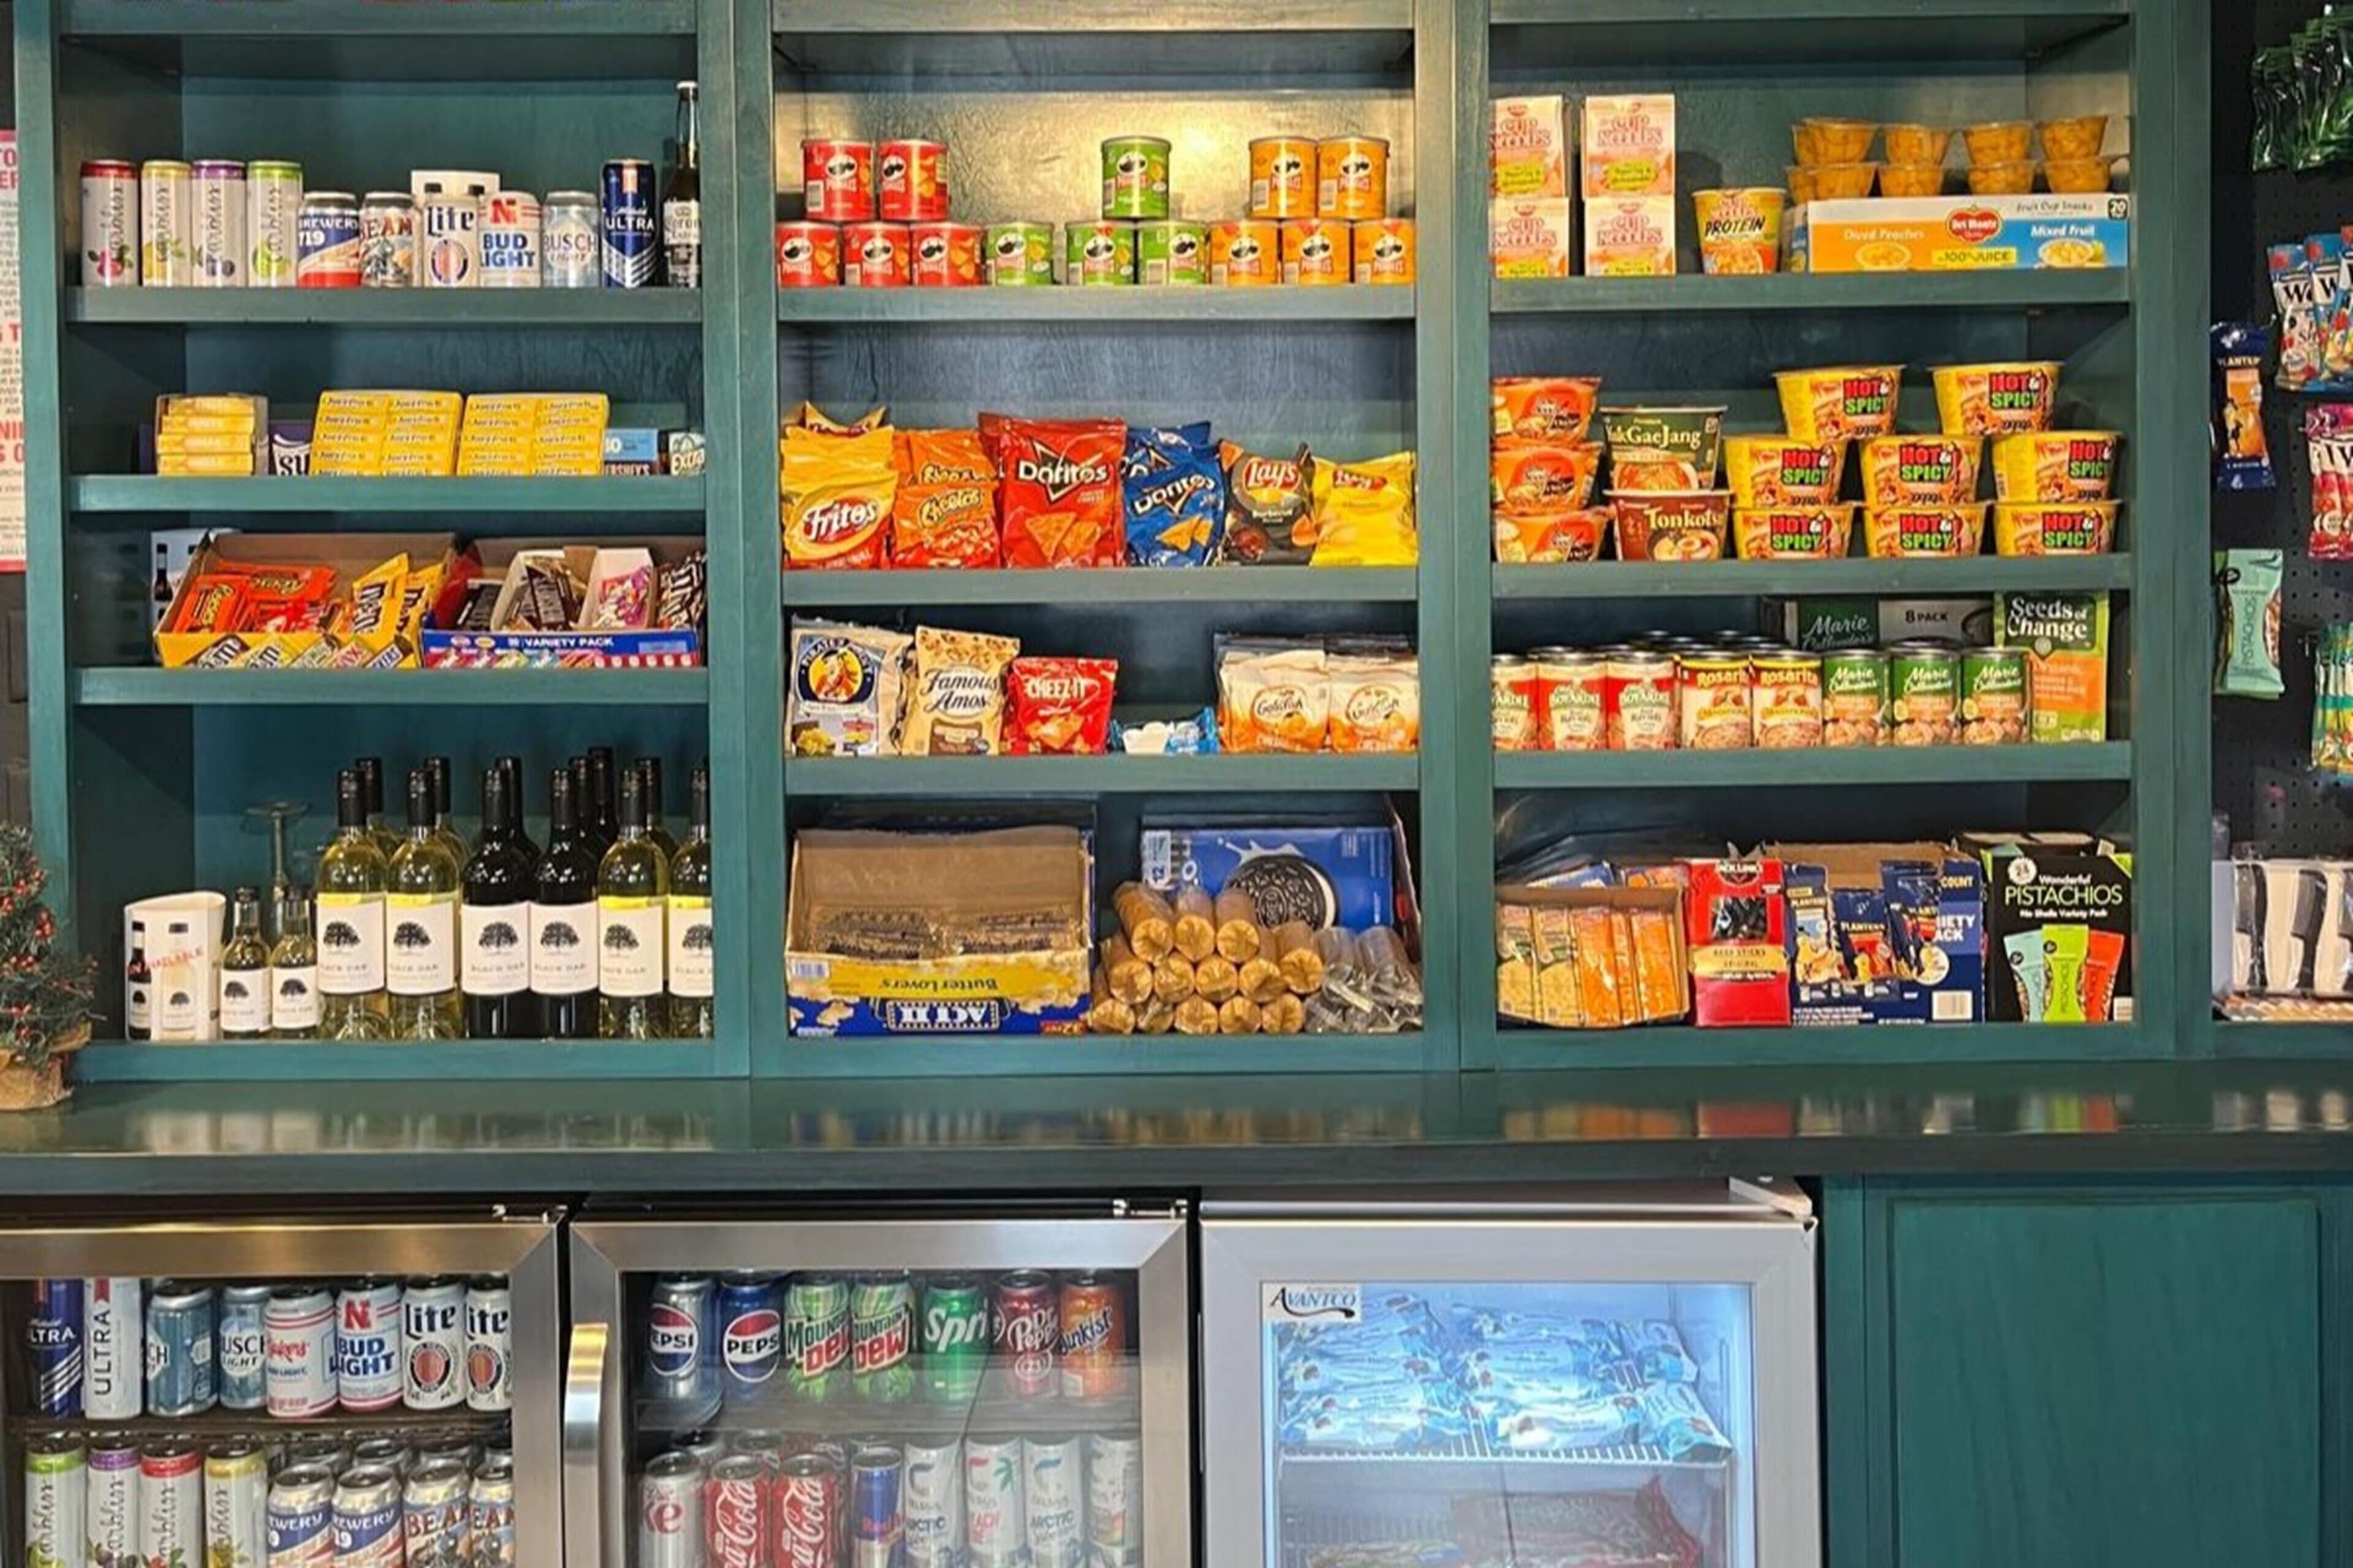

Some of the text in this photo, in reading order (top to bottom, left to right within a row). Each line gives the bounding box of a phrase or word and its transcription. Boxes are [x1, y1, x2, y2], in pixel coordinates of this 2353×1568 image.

[605, 217, 654, 231] ULTRA
[1705, 216, 1766, 237] PROTEIN
[2030, 224, 2096, 238] Mixed Fruit
[483, 233, 528, 249] BUD
[1844, 379, 1881, 398] HOT
[1991, 374, 2029, 391] HOT
[1991, 392, 2039, 408] SPICY
[1783, 450, 1820, 468] HOT
[1900, 446, 1941, 464] HOT
[2071, 442, 2104, 459] HOT
[1018, 458, 1108, 485] Doritos
[1246, 460, 1297, 490] Lay's
[1901, 464, 1952, 481] SPICY
[2071, 461, 2105, 478] SPIC
[1134, 474, 1216, 515] Doritos
[803, 501, 878, 541] Fritos
[1771, 517, 1811, 534] HOT
[1900, 515, 1942, 532] HOT
[2043, 513, 2084, 532] HOT
[1772, 534, 1821, 550] SPICY
[1901, 532, 1954, 549] SPICY
[2044, 531, 2094, 547] SPICY
[1905, 609, 1948, 623] 8 PACK
[2010, 597, 2073, 619] Seeds
[1808, 615, 1869, 637] Marie
[2007, 615, 2088, 642] Change
[525, 637, 614, 647] VARIETY PACK
[920, 667, 999, 697] Famous
[924, 691, 988, 714] Amos
[1940, 876, 1974, 888] COUNT
[2038, 873, 2092, 885] Wonderful
[2004, 884, 2123, 906] PISTACHIOS
[1934, 929, 1964, 942] ACK
[939, 979, 999, 991] Butter
[935, 1005, 988, 1022] ACT
[1270, 1286, 1356, 1319] AVANTCO
[405, 1303, 457, 1341] Lite
[925, 1298, 988, 1352] Spri
[30, 1327, 76, 1343] LTRA
[652, 1333, 694, 1347] EPSI
[93, 1309, 112, 1396] ULTRA
[338, 1337, 385, 1357] BUD
[727, 1335, 779, 1354] PEPS
[329, 1352, 395, 1375] LIGHT
